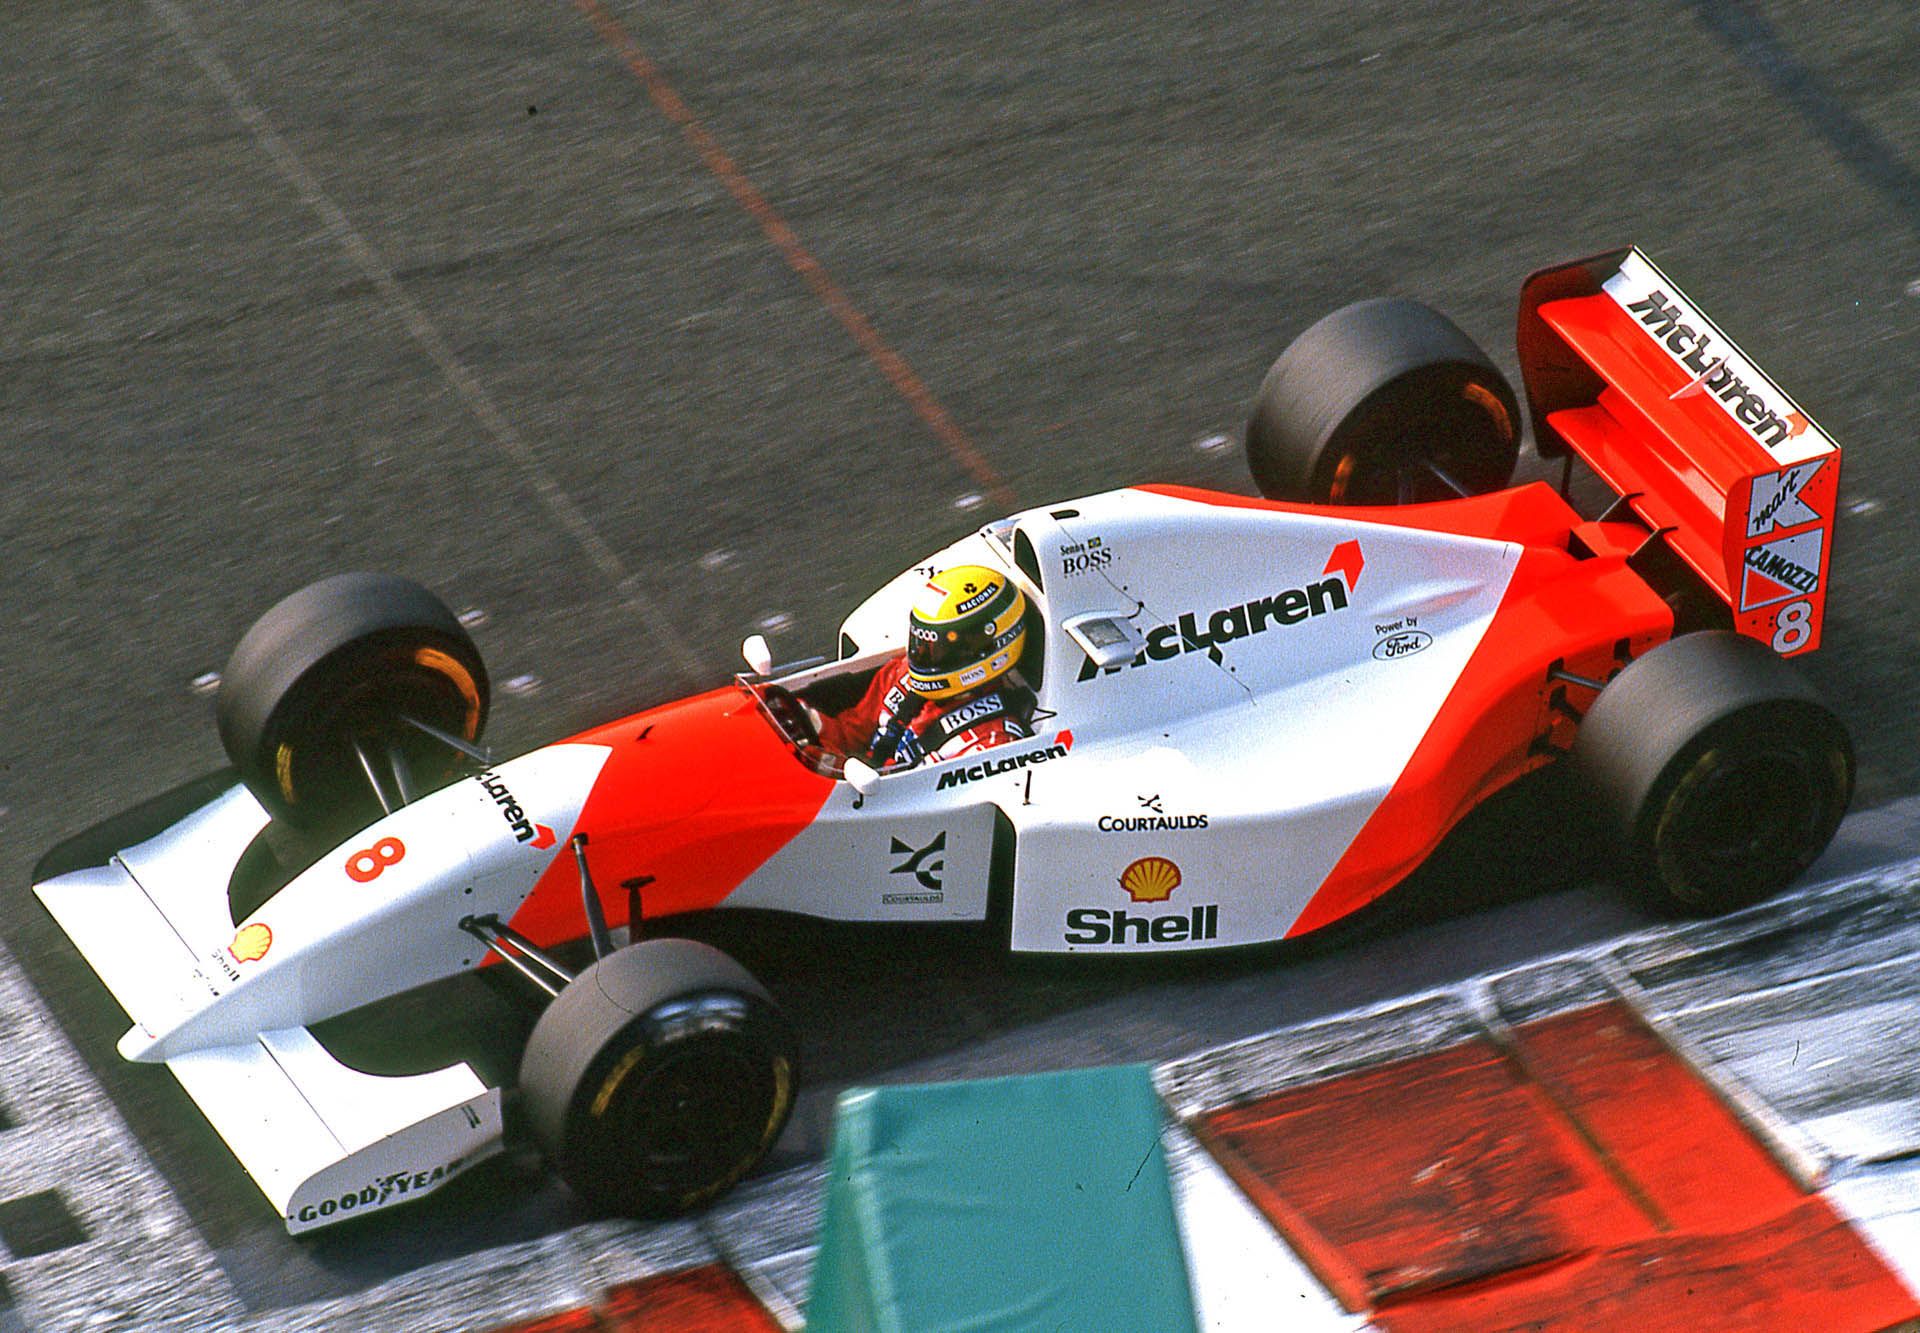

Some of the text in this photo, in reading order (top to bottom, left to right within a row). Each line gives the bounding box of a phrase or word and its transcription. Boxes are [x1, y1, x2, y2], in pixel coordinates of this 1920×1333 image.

[1063, 547, 1112, 574] BOSS
[1744, 544, 1819, 594] CAMOZZI
[959, 584, 997, 612] NACIONAL
[1375, 615, 1418, 636] Power by
[1772, 600, 1813, 654] 8
[1385, 635, 1421, 657] Ford
[961, 668, 986, 682] BOSS
[946, 695, 1001, 729] BOSS
[936, 745, 1067, 791] McLaren
[1098, 814, 1208, 832] COURTAULDS
[345, 836, 406, 883] 8
[1064, 905, 1218, 944] Shell
